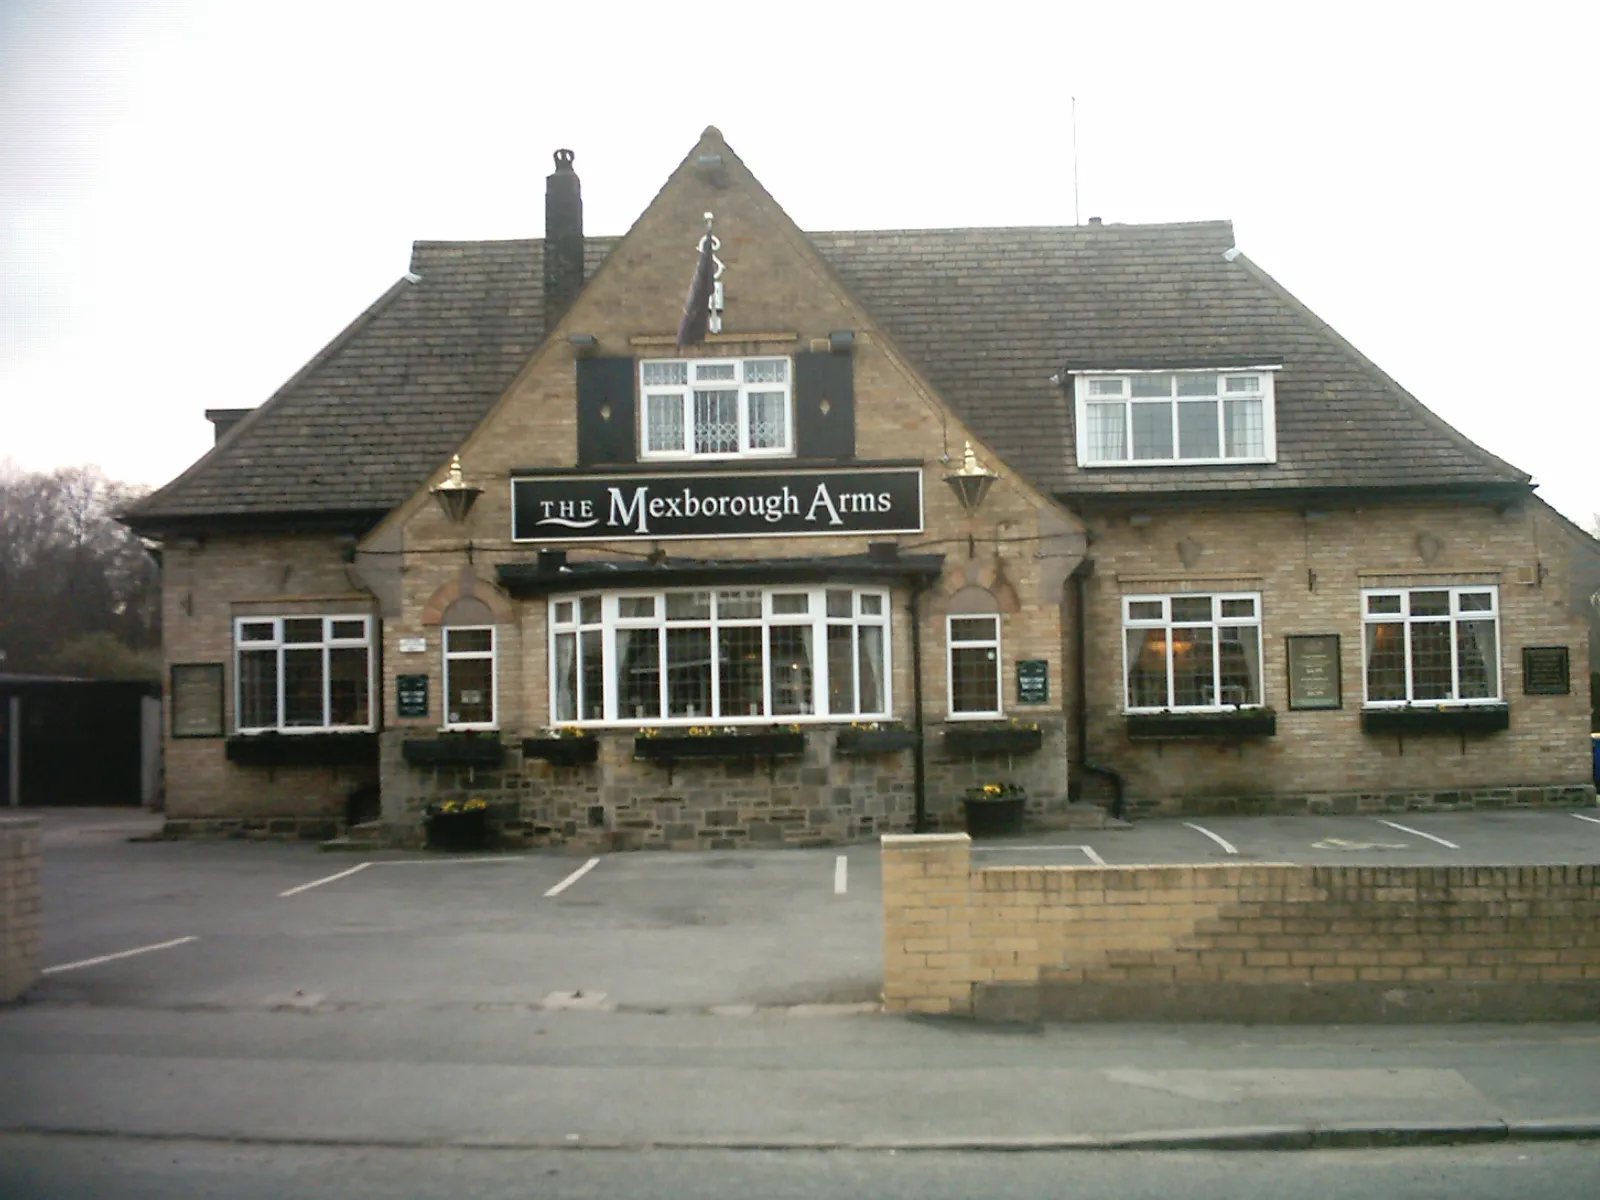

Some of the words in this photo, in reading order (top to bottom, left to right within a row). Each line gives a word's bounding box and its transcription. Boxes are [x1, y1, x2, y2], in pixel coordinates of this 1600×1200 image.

[540, 500, 593, 518] THE
[606, 486, 800, 533] Mexborough
[804, 482, 892, 525] Arms
